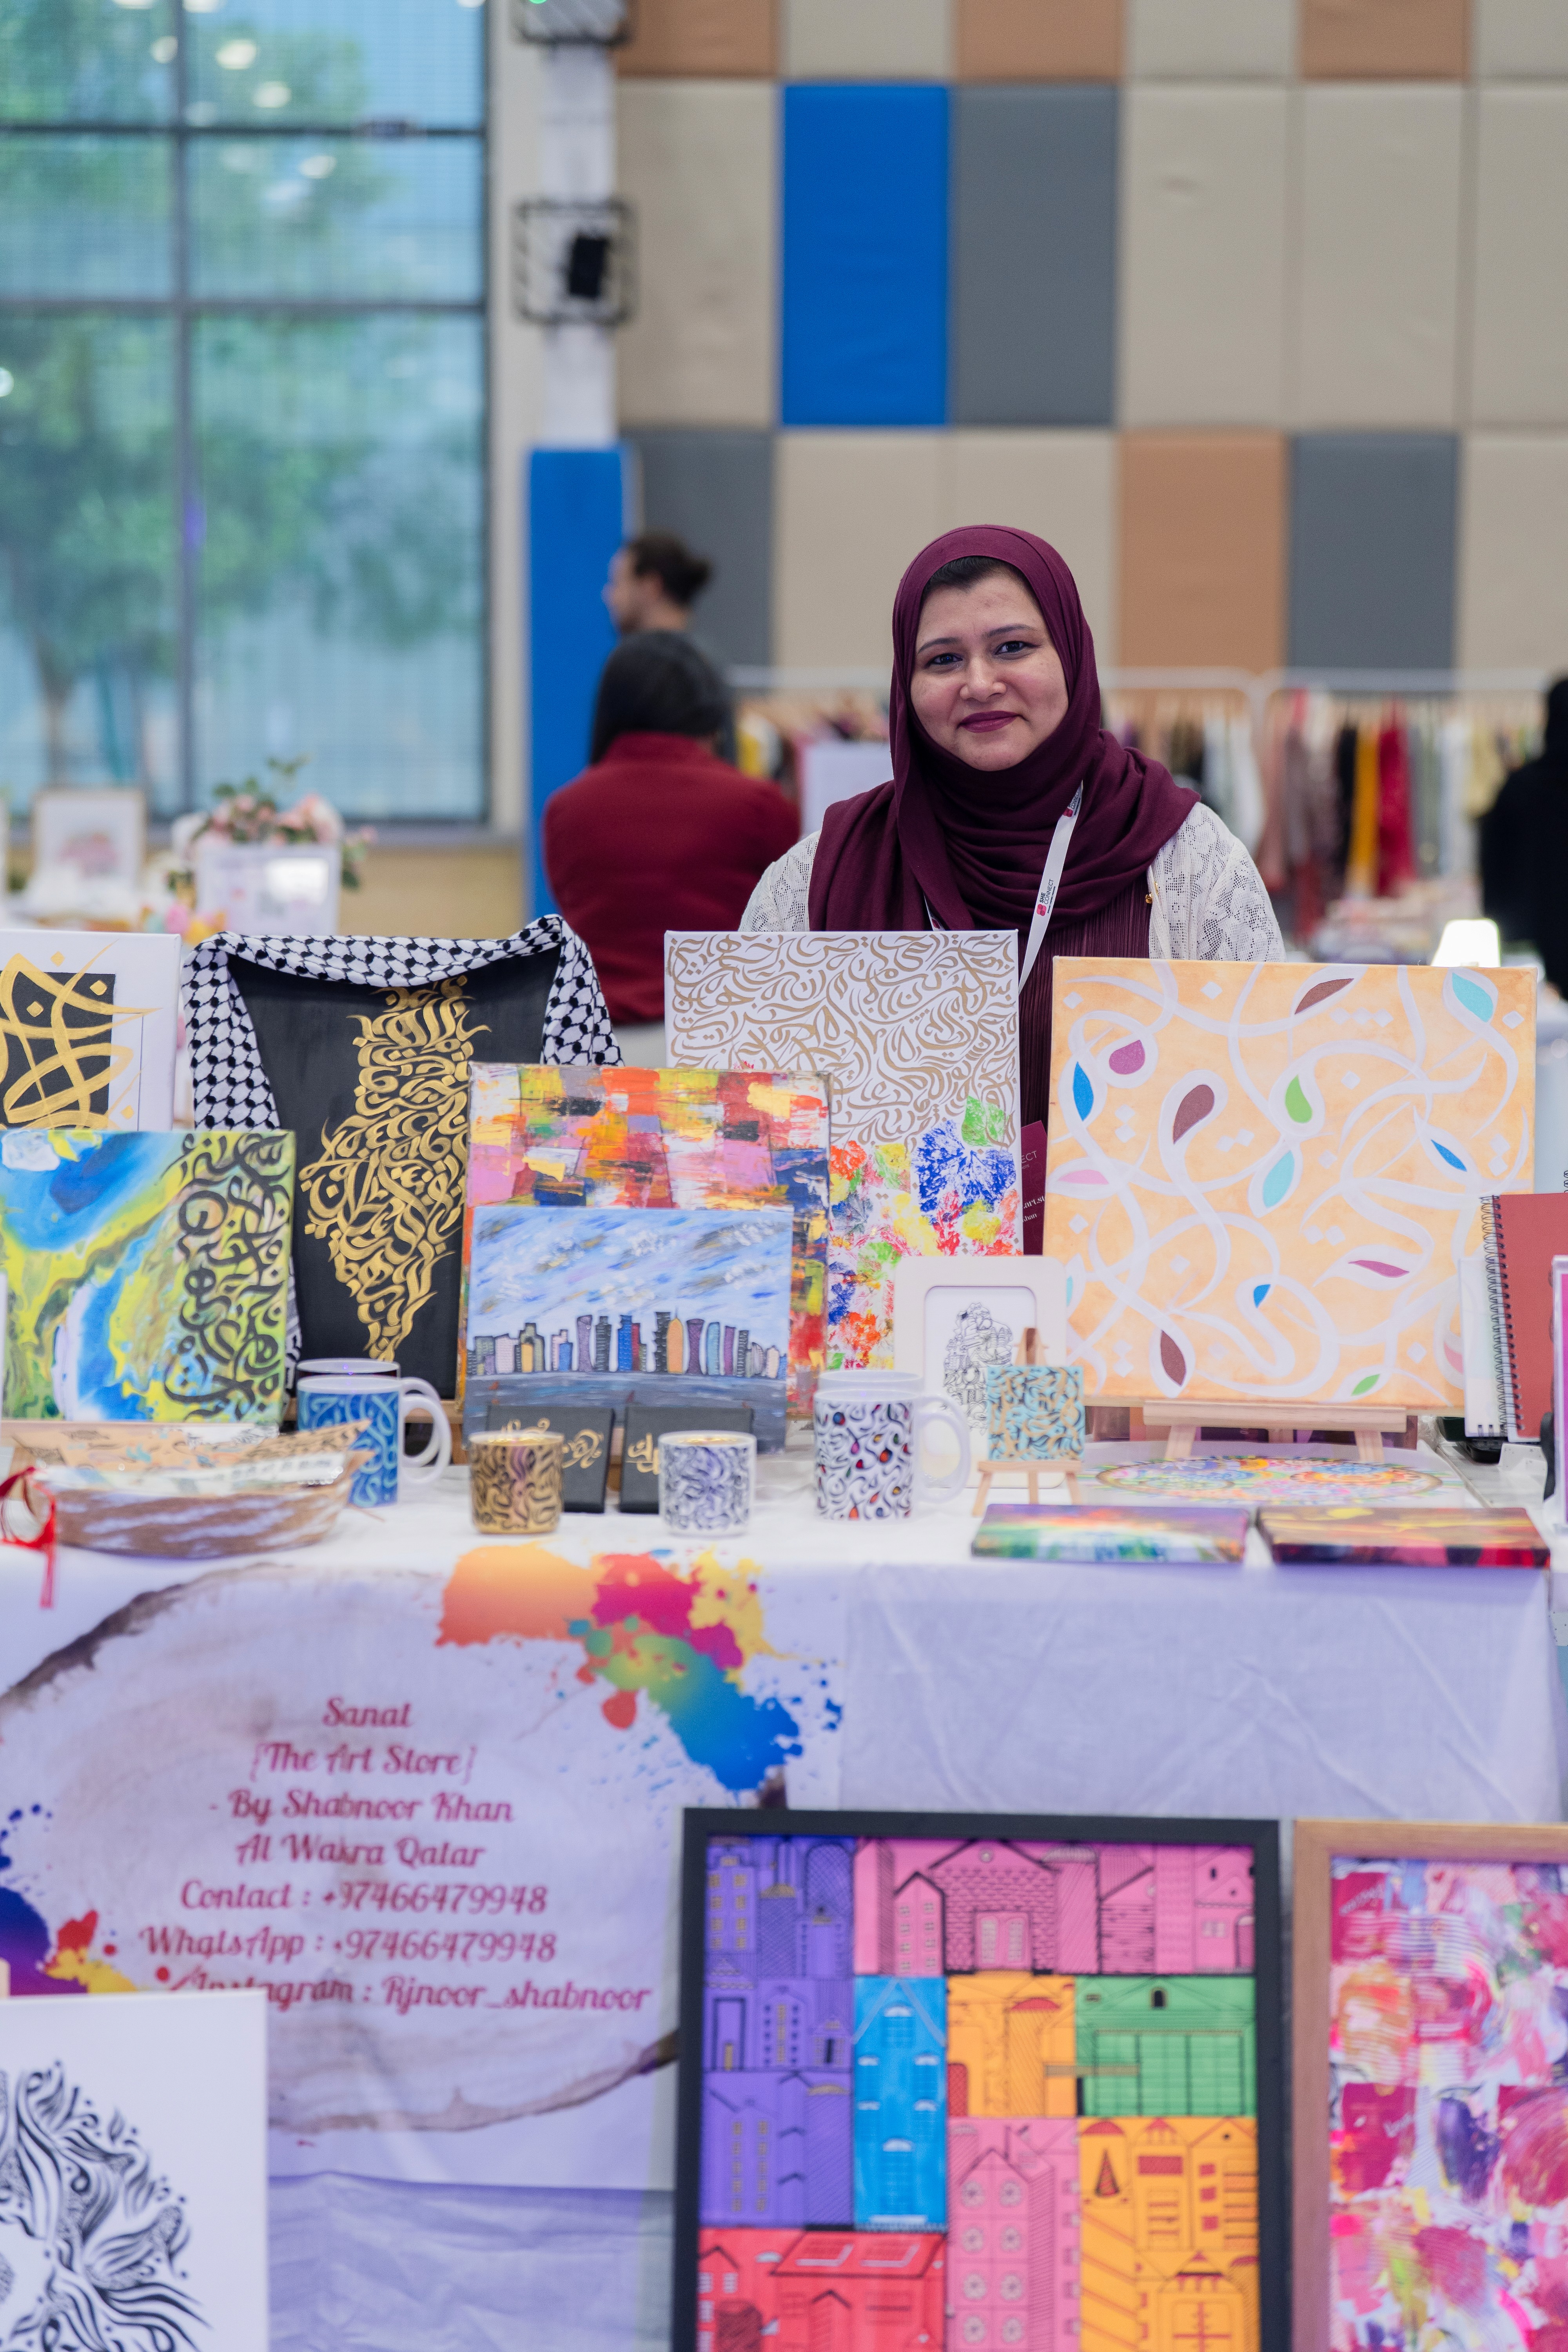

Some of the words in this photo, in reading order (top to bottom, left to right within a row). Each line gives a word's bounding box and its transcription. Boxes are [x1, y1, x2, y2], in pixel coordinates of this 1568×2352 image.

[1044, 878, 1054, 904] CONNECT
[322, 1697, 411, 1727] Sanat
[326, 1743, 373, 1775] Art
[228, 1788, 272, 1826] By
[281, 1788, 423, 1820] Shabnoor
[432, 1792, 514, 1822] Khan
[236, 1833, 272, 1865] Al
[280, 1833, 385, 1866] Wakra
[395, 1835, 486, 1869] Qatar
[181, 1880, 292, 1909] Contact
[323, 1881, 548, 1915] +97466479948
[138, 1925, 305, 1963] WhatsApp
[334, 1929, 557, 1962] +97466479948
